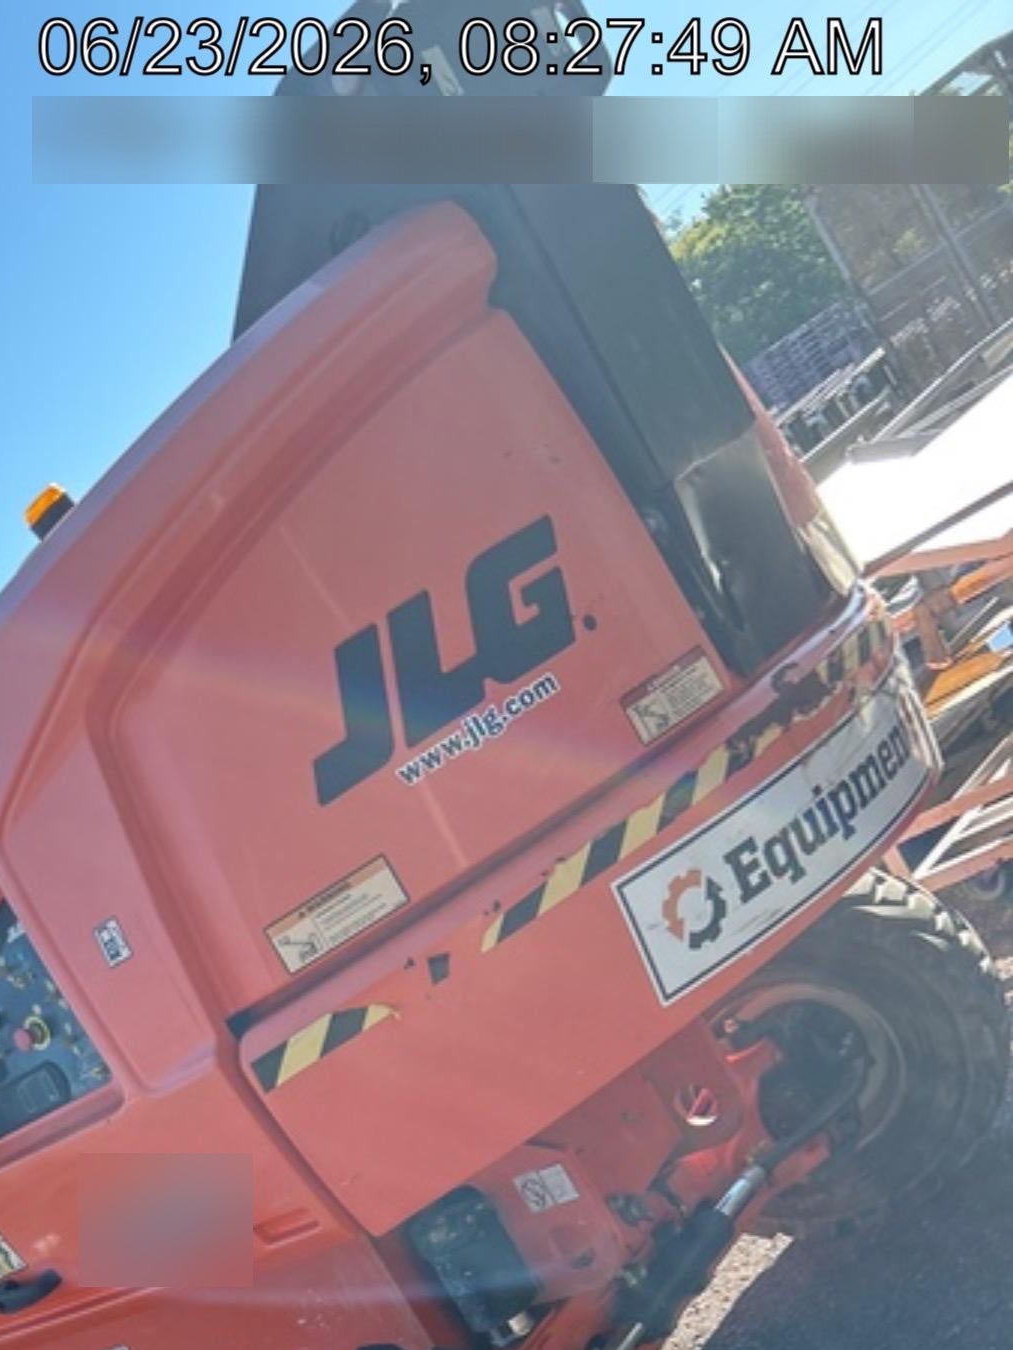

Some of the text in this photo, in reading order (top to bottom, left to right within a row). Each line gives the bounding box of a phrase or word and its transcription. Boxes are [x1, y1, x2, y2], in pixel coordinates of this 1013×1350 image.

[313, 513, 576, 807] JLG
[397, 673, 559, 786] www.jlg.com
[723, 719, 909, 904] Equipmen
